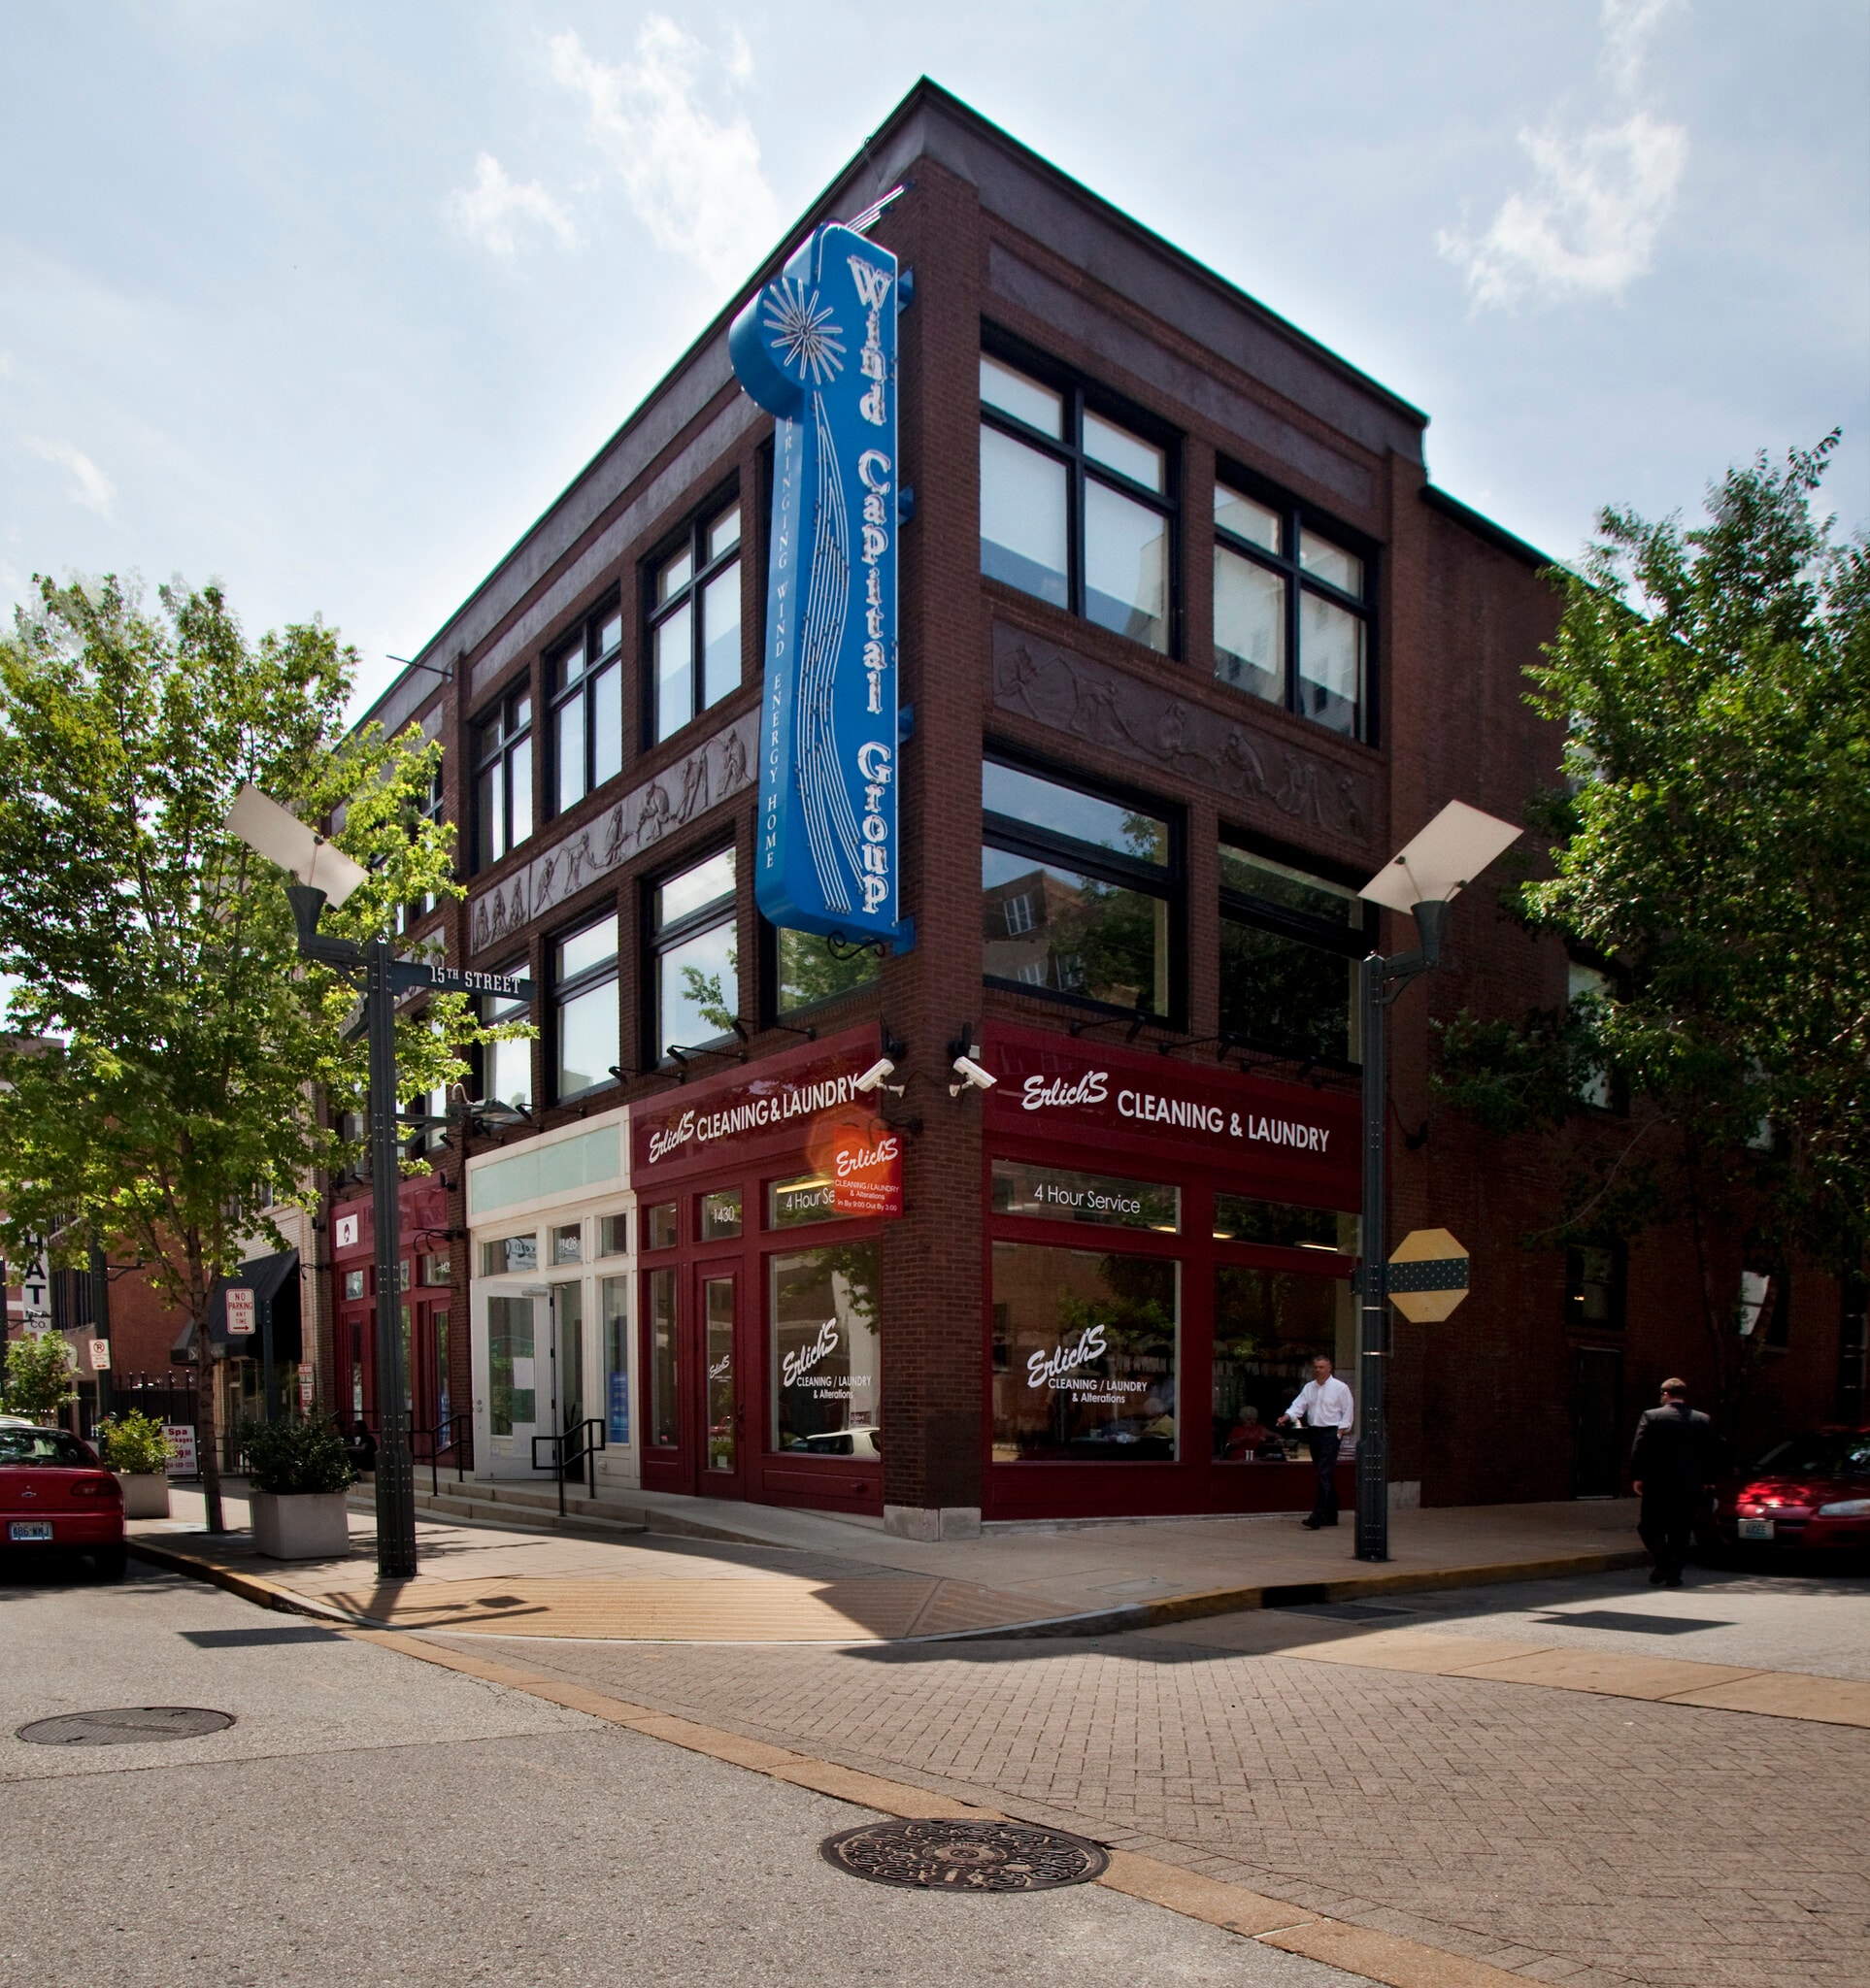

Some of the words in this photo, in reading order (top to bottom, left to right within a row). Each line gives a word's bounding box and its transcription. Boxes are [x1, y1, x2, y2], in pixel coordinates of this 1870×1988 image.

[847, 254, 894, 426] Wind
[779, 416, 792, 569] BRINGING
[858, 449, 890, 714] Capital
[776, 583, 788, 658] WIND
[770, 674, 782, 784] ENERGY
[765, 797, 778, 870] HOME
[857, 742, 891, 914] Group
[430, 966, 459, 984] 15TH
[465, 971, 520, 994] STREET
[696, 1100, 769, 1143] CLEANING
[770, 1097, 782, 1122] &
[783, 1073, 859, 1118] LAUNDRY
[1118, 1090, 1223, 1133] CLEANING
[1229, 1112, 1243, 1138] &
[1249, 1114, 1329, 1152] LAUNDRY
[835, 1178, 867, 1190] CLEANING
[871, 1183, 900, 1194] LAUNDRY
[856, 1190, 885, 1201] Alterations
[1034, 1183, 1044, 1202] 4
[1048, 1185, 1085, 1208] Hour
[1086, 1190, 1141, 1214] Service
[714, 1205, 735, 1223] 1430
[785, 1195, 793, 1210] 4
[795, 1191, 821, 1209] Hour
[844, 1199, 852, 1208] By
[235, 1292, 247, 1301] NO
[796, 1376, 832, 1387] CLEANING
[839, 1375, 872, 1387] LAUNDRY
[813, 1389, 818, 1399] &
[819, 1388, 854, 1399] Alterations
[1048, 1378, 1098, 1389] CLEANING
[1106, 1380, 1148, 1392] LAUNDRY
[1072, 1392, 1079, 1403] &
[1081, 1392, 1126, 1404] Alterations
